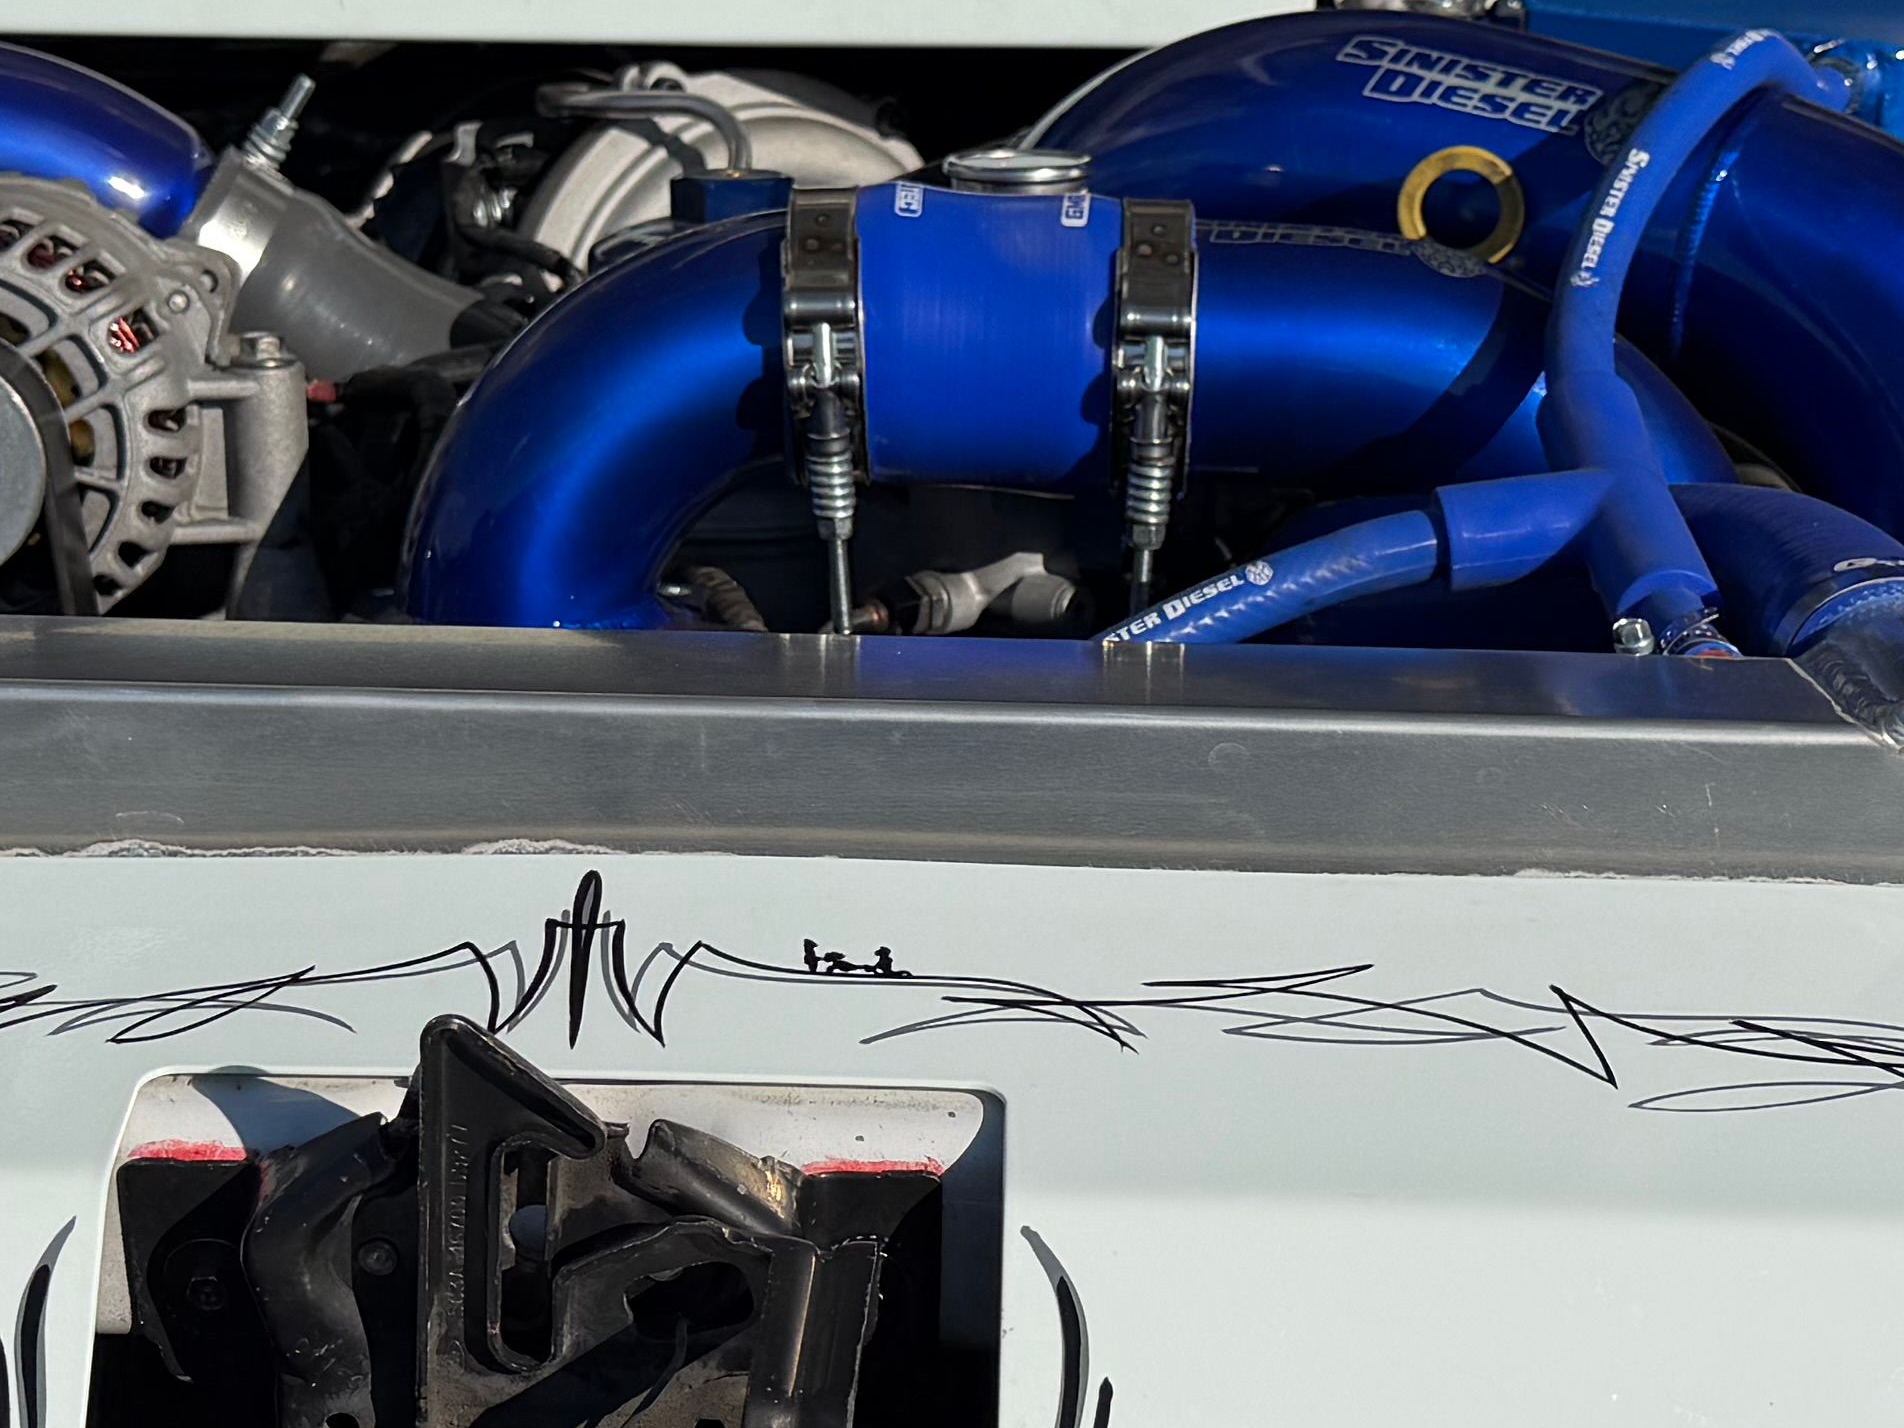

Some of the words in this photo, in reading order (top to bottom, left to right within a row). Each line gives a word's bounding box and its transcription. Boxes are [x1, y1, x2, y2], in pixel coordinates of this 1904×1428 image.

[1336, 35, 1604, 110] SINISTER
[1362, 65, 1585, 136] DIESEL
[1162, 575, 1246, 620] DIESEL
